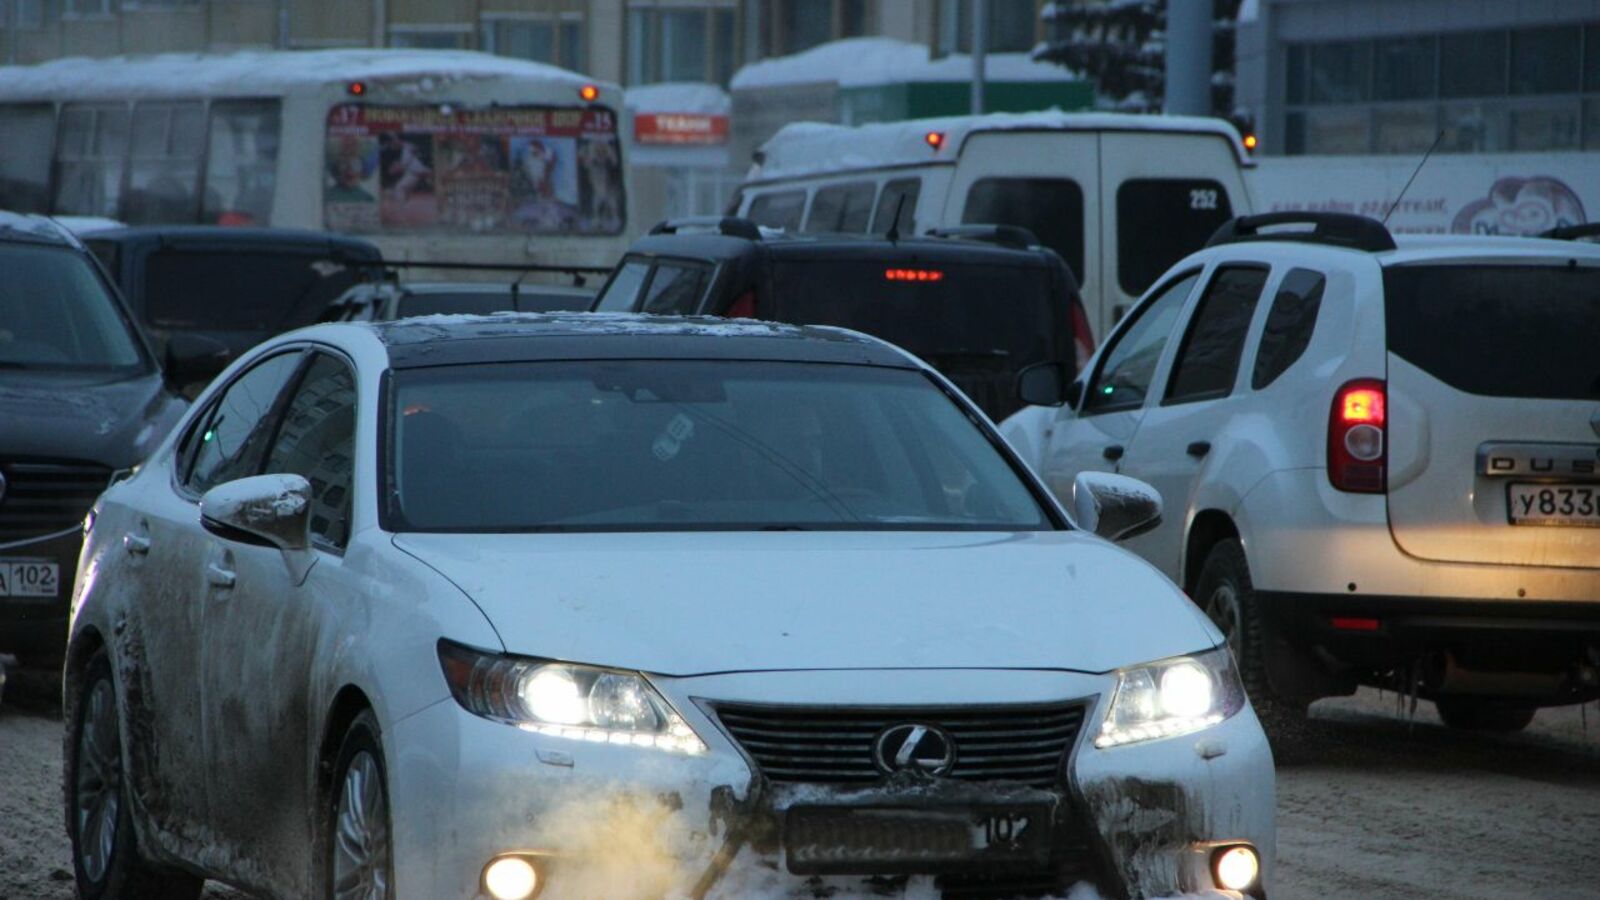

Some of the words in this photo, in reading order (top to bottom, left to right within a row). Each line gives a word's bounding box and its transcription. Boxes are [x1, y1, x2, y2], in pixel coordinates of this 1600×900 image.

[1190, 189, 1217, 209] 252
[1491, 457, 1596, 473] DUS
[1520, 488, 1600, 516] У833
[14, 565, 52, 585] 102
